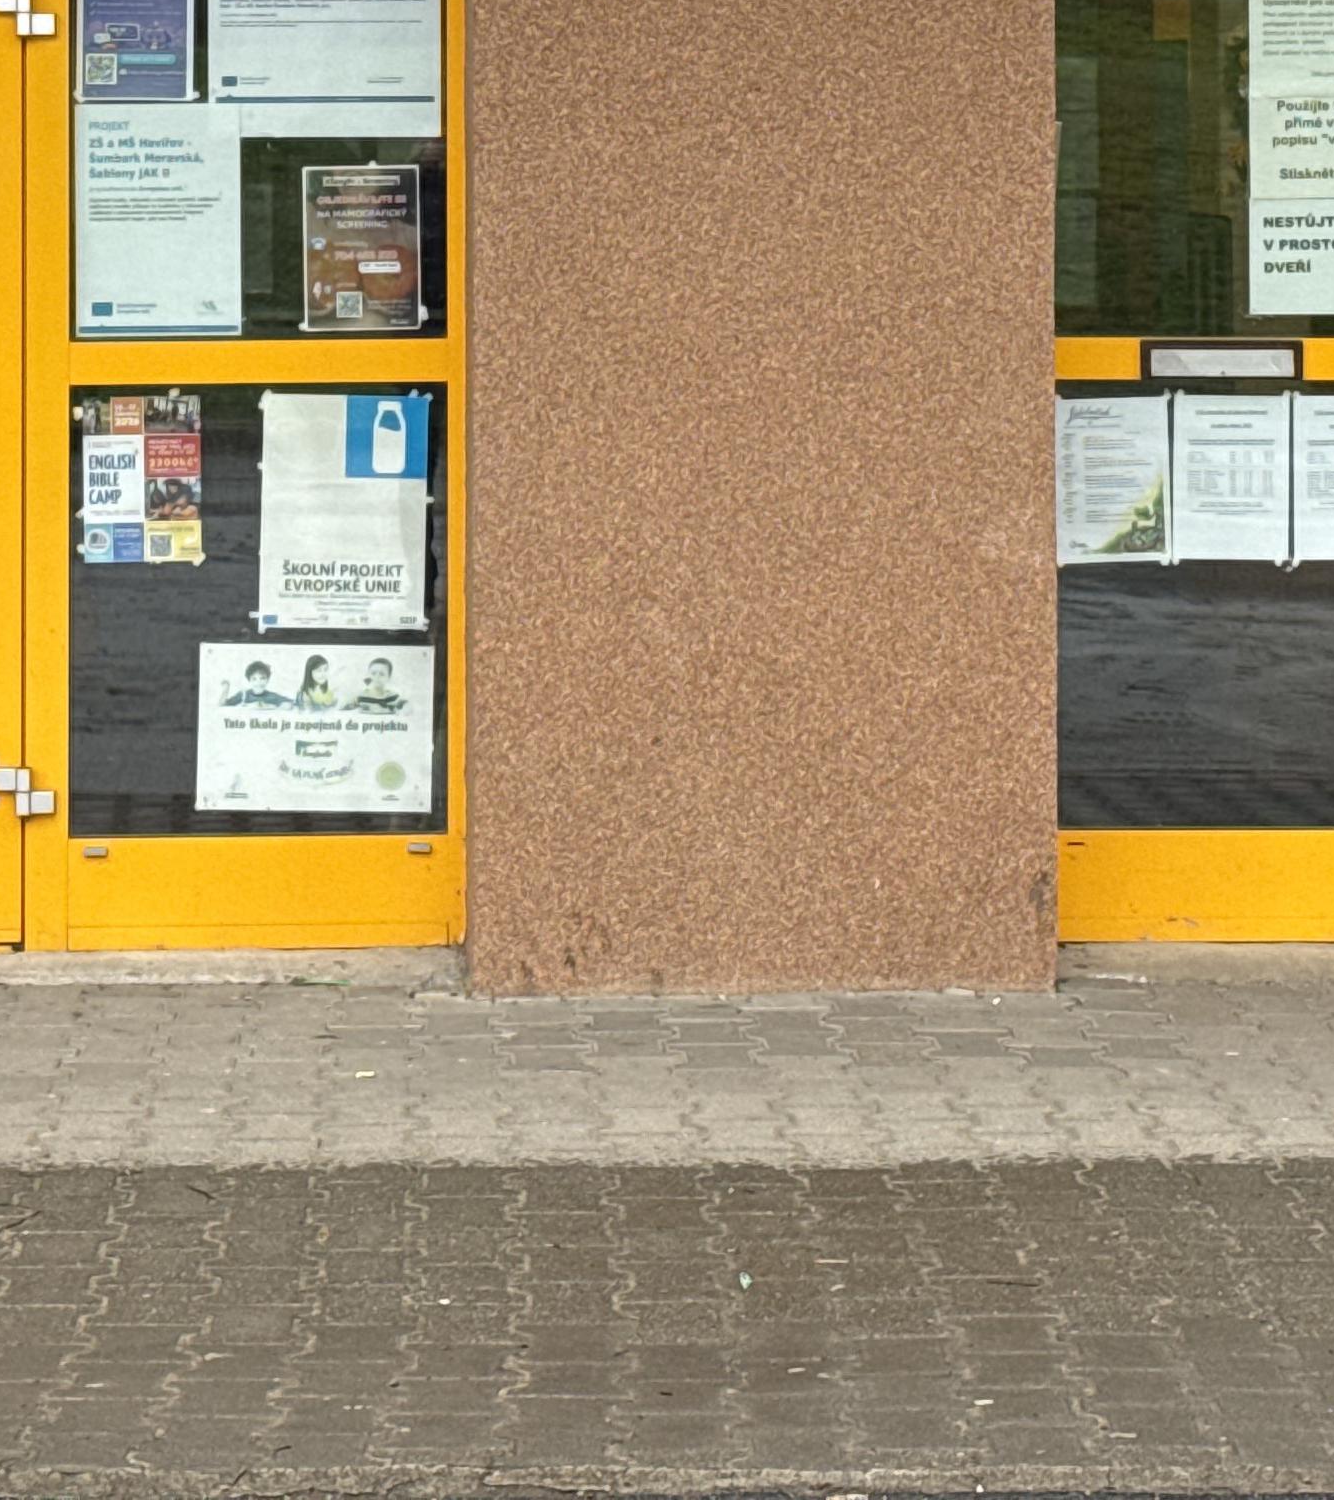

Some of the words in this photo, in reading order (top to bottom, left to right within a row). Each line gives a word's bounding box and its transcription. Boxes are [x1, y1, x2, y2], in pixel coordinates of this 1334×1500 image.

[1276, 100, 1330, 115] Použijte
[89, 121, 130, 132] PROJEKT
[1284, 116, 1323, 131] přímé
[139, 137, 185, 148] Havířov
[1272, 134, 1318, 148] popisu
[138, 168, 158, 180] JAK
[1263, 239, 1274, 251] V
[1264, 258, 1312, 274] DVEŘÍ
[89, 454, 136, 470] ENGLISH
[89, 472, 120, 487] BIBLE
[89, 489, 122, 505] CAMP
[283, 560, 336, 577] ŠKOLNÍ
[340, 564, 404, 577] PROJEKT
[285, 577, 361, 593] EVROPSKÉ
[365, 580, 401, 593] UNIE
[224, 718, 245, 729] Tato
[249, 719, 278, 730] škola
[281, 719, 291, 733] je
[294, 719, 342, 733] zapojená
[346, 719, 359, 731] do
[362, 719, 409, 734] projektu
